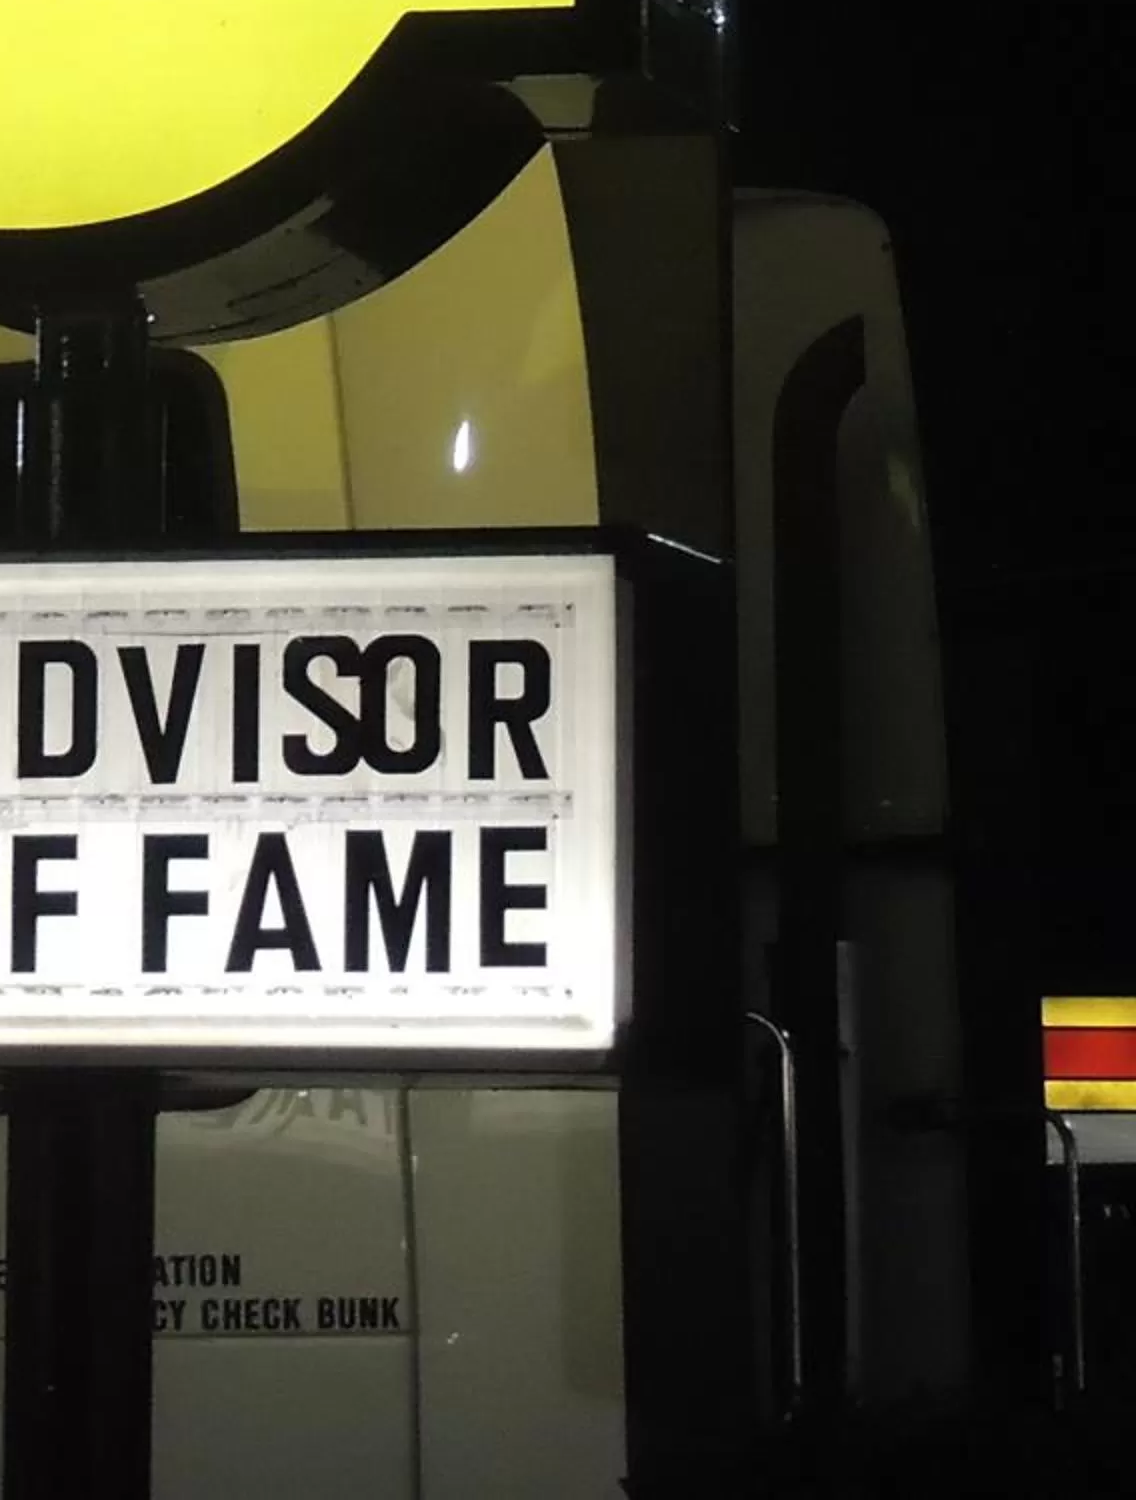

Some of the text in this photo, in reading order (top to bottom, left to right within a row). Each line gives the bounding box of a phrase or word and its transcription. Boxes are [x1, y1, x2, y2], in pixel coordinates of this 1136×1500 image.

[141, 826, 549, 974] FAME
[201, 1298, 300, 1332] CHECK
[317, 1296, 400, 1329] BUNK
